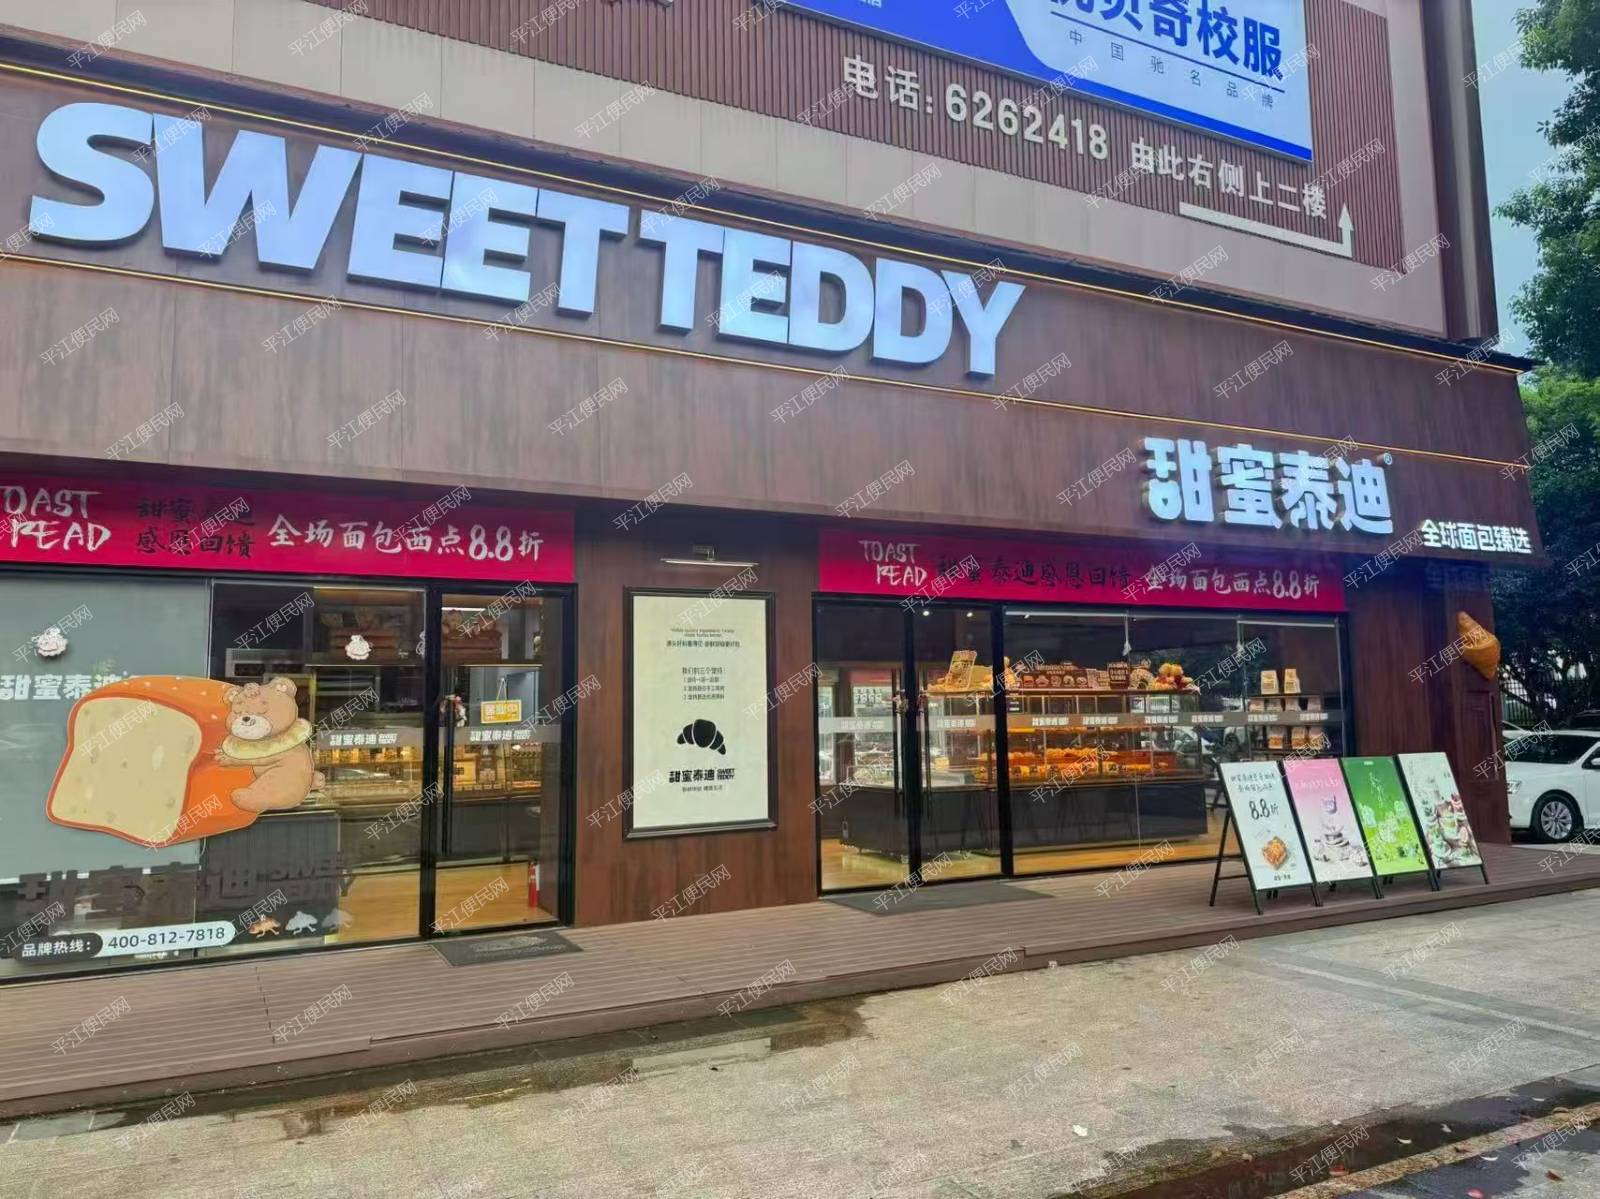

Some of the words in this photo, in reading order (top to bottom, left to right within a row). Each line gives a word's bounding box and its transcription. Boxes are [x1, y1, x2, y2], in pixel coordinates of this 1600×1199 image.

[1131, 137, 1327, 220] 由此右侧上二楼
[29, 102, 630, 316] SWEET
[640, 209, 1026, 379] TEDDY
[1142, 437, 1393, 533] 甜蜜泰迪
[267, 514, 545, 562] 全场面包西点8.8折
[1420, 519, 1532, 554] 全球面包臻选
[330, 733, 376, 746] 甜蜜泰迪
[470, 730, 512, 742] 甜蜜泰迪
[669, 769, 715, 783] 甜蜜泰迪
[108, 927, 225, 949] 400-812-7818
